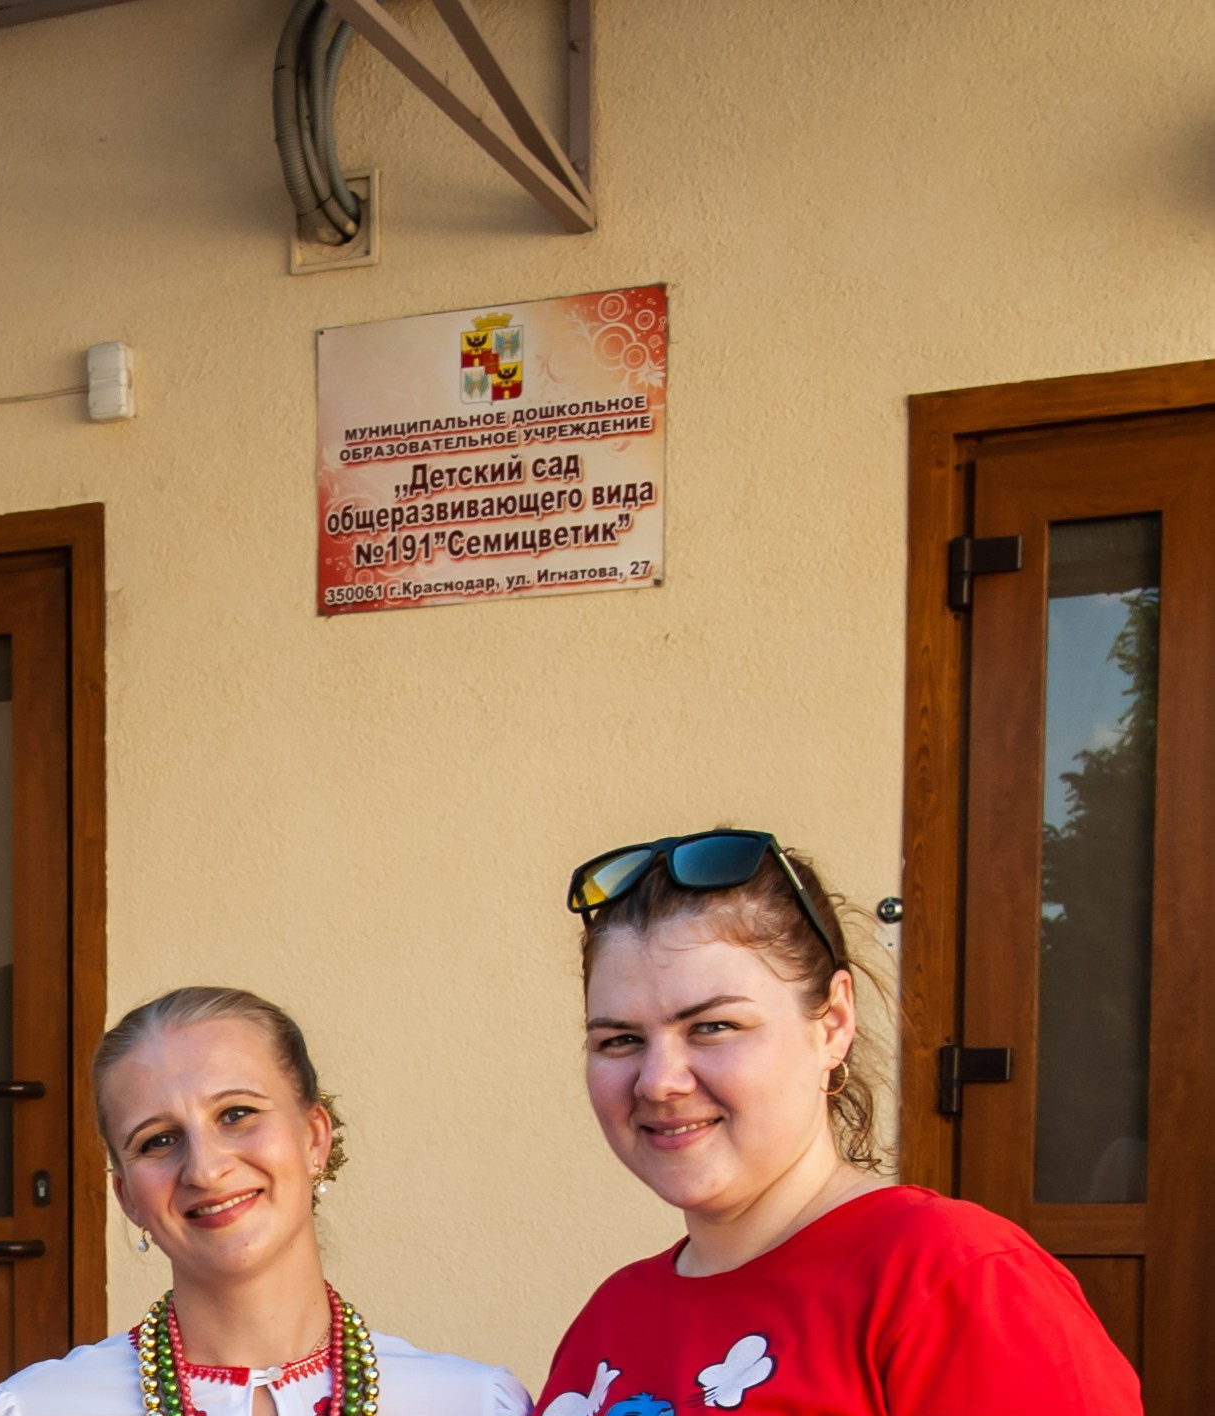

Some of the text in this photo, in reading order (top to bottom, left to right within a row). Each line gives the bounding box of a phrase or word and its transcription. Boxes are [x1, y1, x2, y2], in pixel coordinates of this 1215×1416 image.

[339, 416, 651, 462] ОБРАЗОВАТЕЛЬНОЕ УЧРЕЖДЕНИЕ
[344, 395, 646, 441] МУНИЦИПАЛЬНОЕ ДОШКОЛЬНОЕ
[532, 454, 580, 483] сад
[327, 480, 654, 533] общеразвивающего вида
[325, 560, 651, 604] 350061 г.Краснодар, ул. Игнатова, 27
